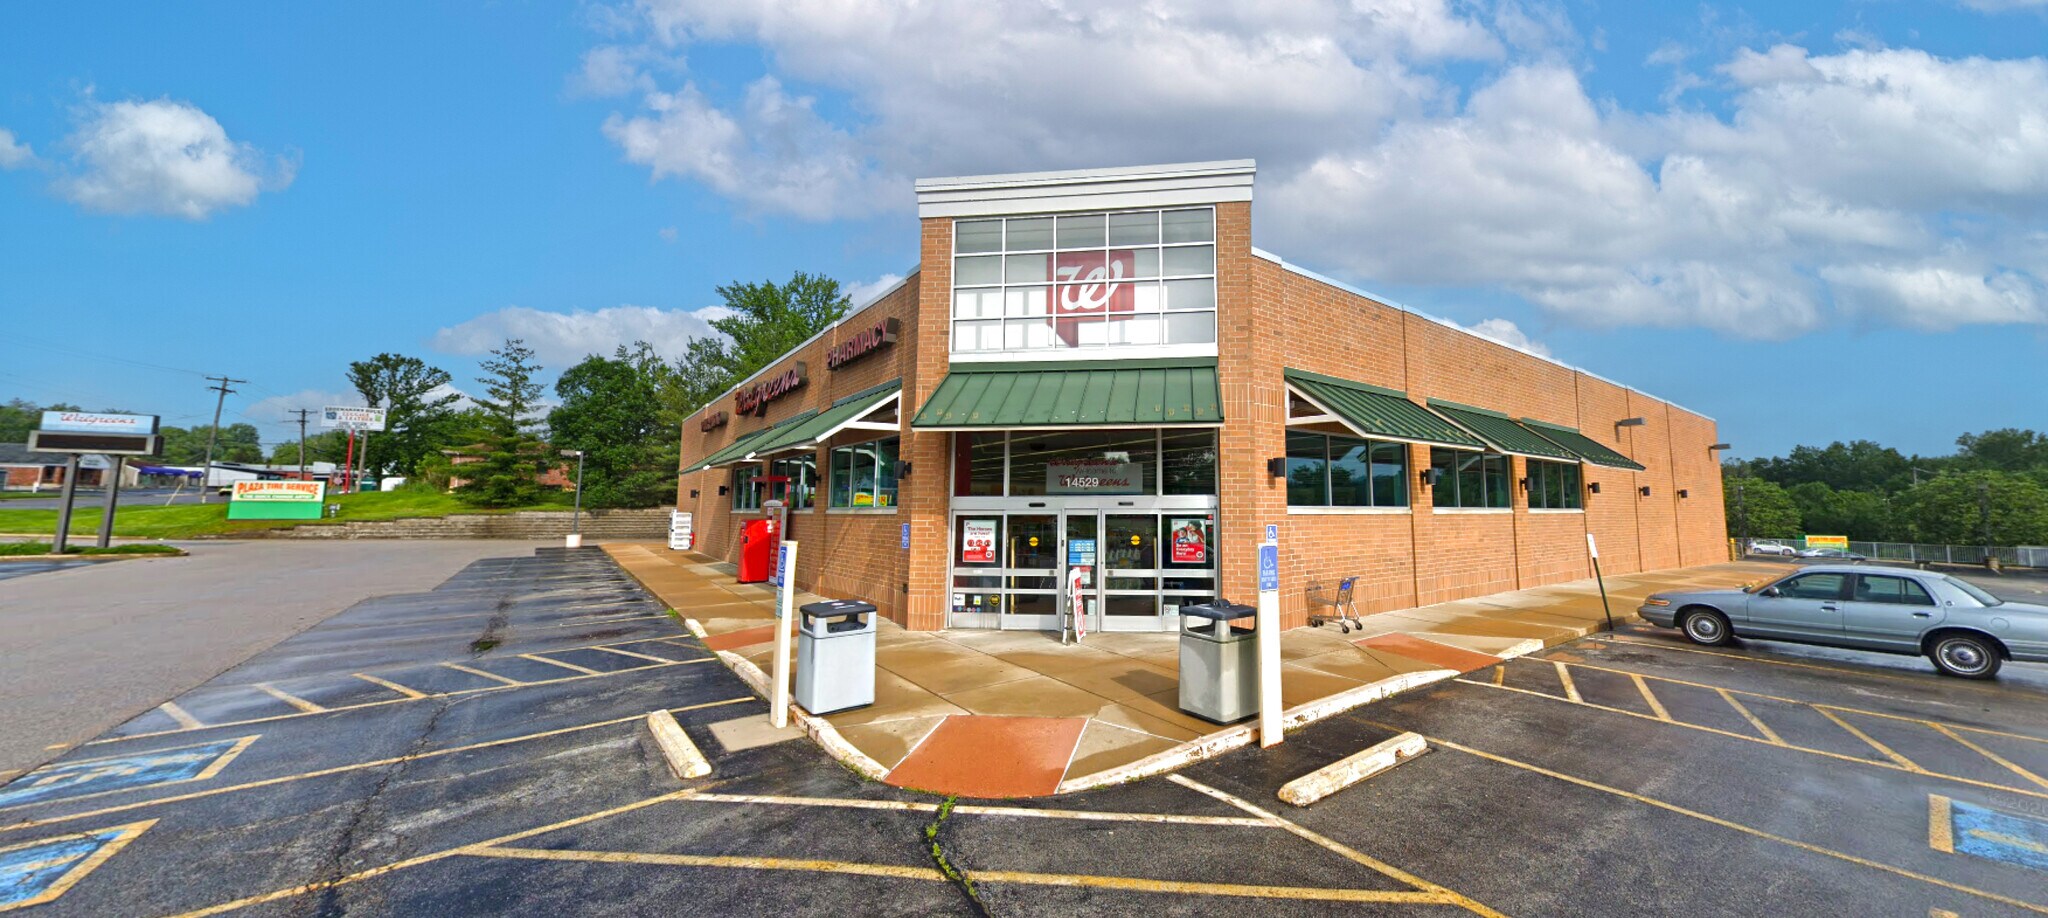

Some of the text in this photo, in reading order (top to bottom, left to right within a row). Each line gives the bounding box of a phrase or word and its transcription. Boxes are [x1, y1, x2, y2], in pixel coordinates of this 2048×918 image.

[826, 320, 888, 368] PHARMACY
[735, 369, 800, 417] Walgreens
[60, 413, 137, 425] Walgreens
[237, 482, 264, 495] PLAZA
[286, 483, 319, 494] SERVICE
[1065, 477, 1099, 488] 14529
